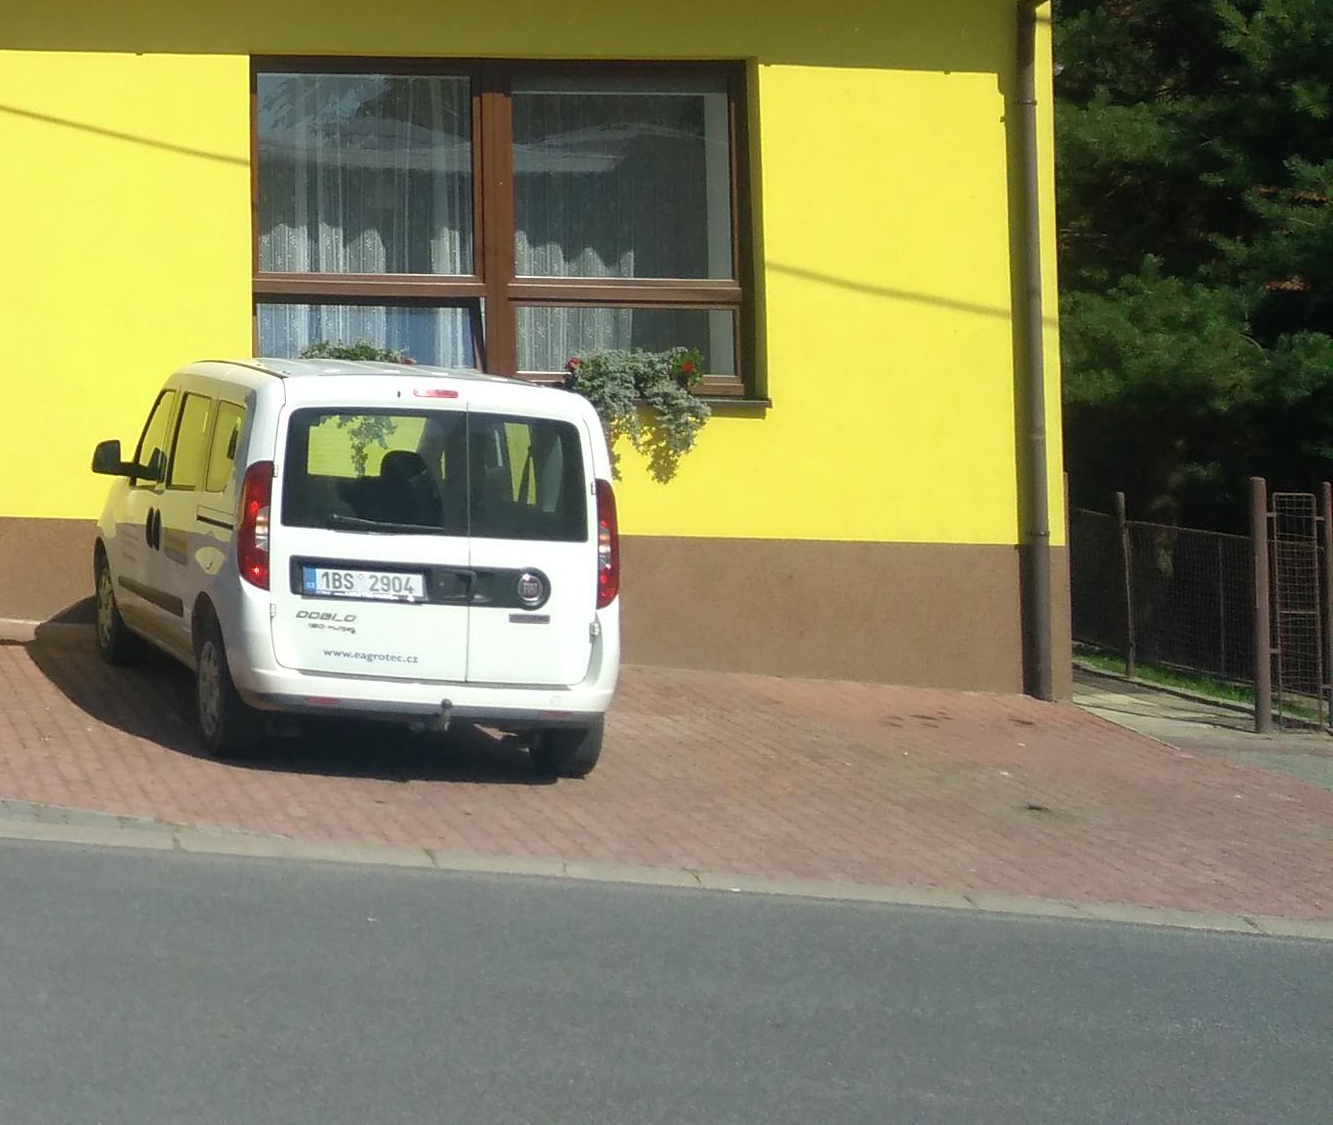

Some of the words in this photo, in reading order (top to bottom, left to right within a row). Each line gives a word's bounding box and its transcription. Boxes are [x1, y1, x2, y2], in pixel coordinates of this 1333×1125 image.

[321, 570, 355, 591] 1BS
[369, 574, 414, 594] 2904
[295, 610, 357, 623] DOBLO
[323, 649, 419, 664] www.eagrotec.cz
